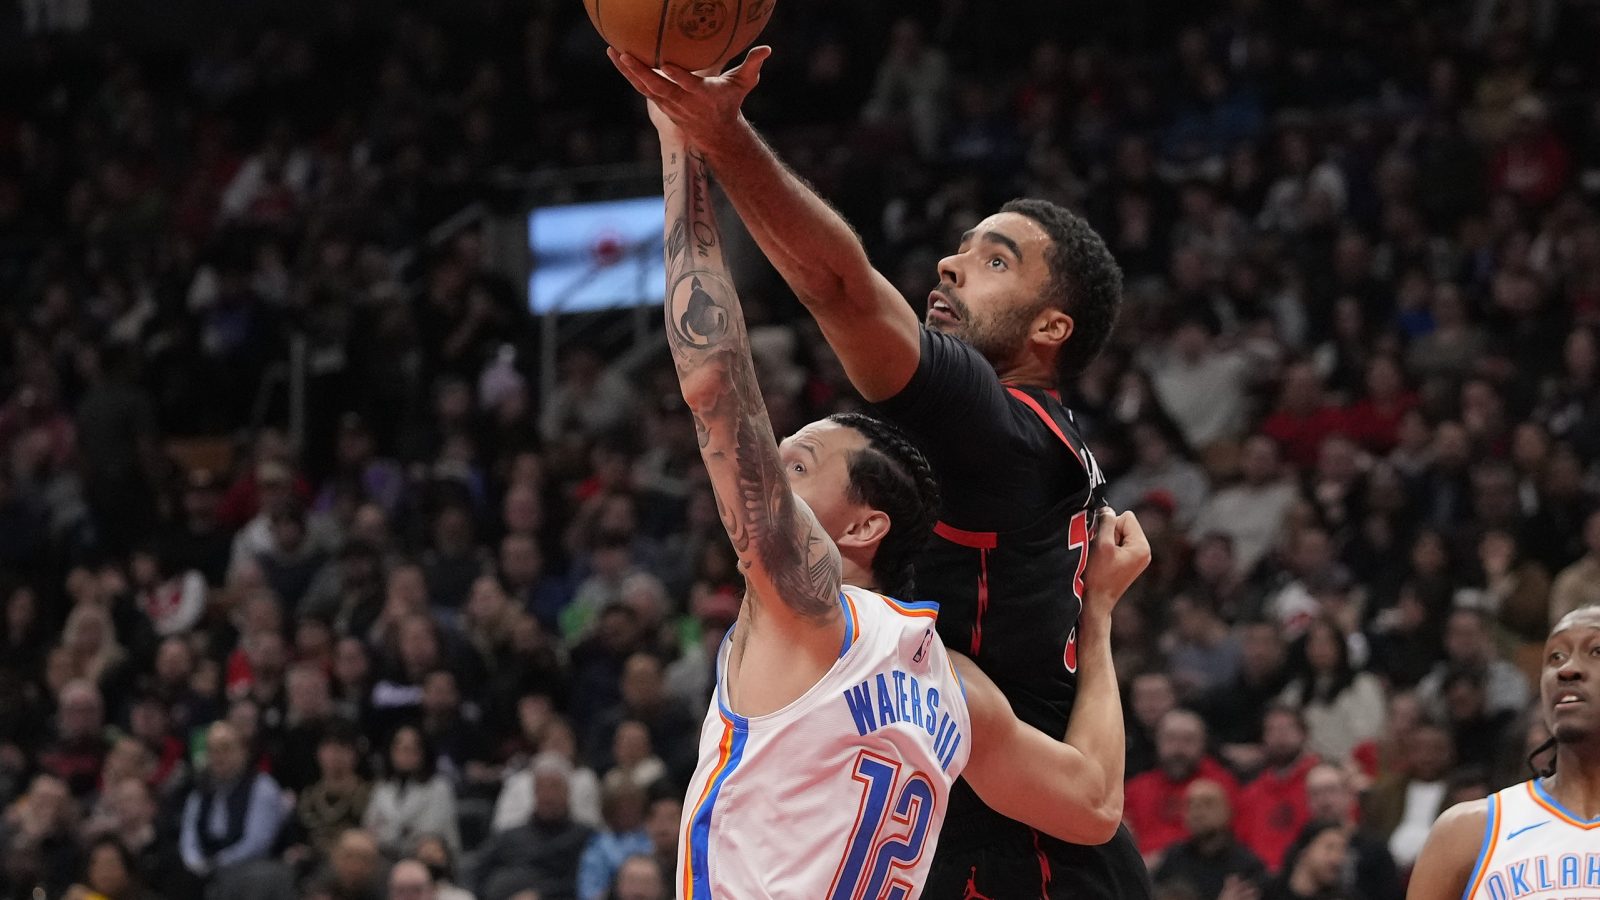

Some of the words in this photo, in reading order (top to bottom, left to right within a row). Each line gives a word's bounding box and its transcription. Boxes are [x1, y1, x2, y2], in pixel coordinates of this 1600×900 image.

[693, 220, 716, 258] On
[843, 670, 940, 737] WATERS
[933, 711, 961, 772] III
[825, 749, 937, 900] 12
